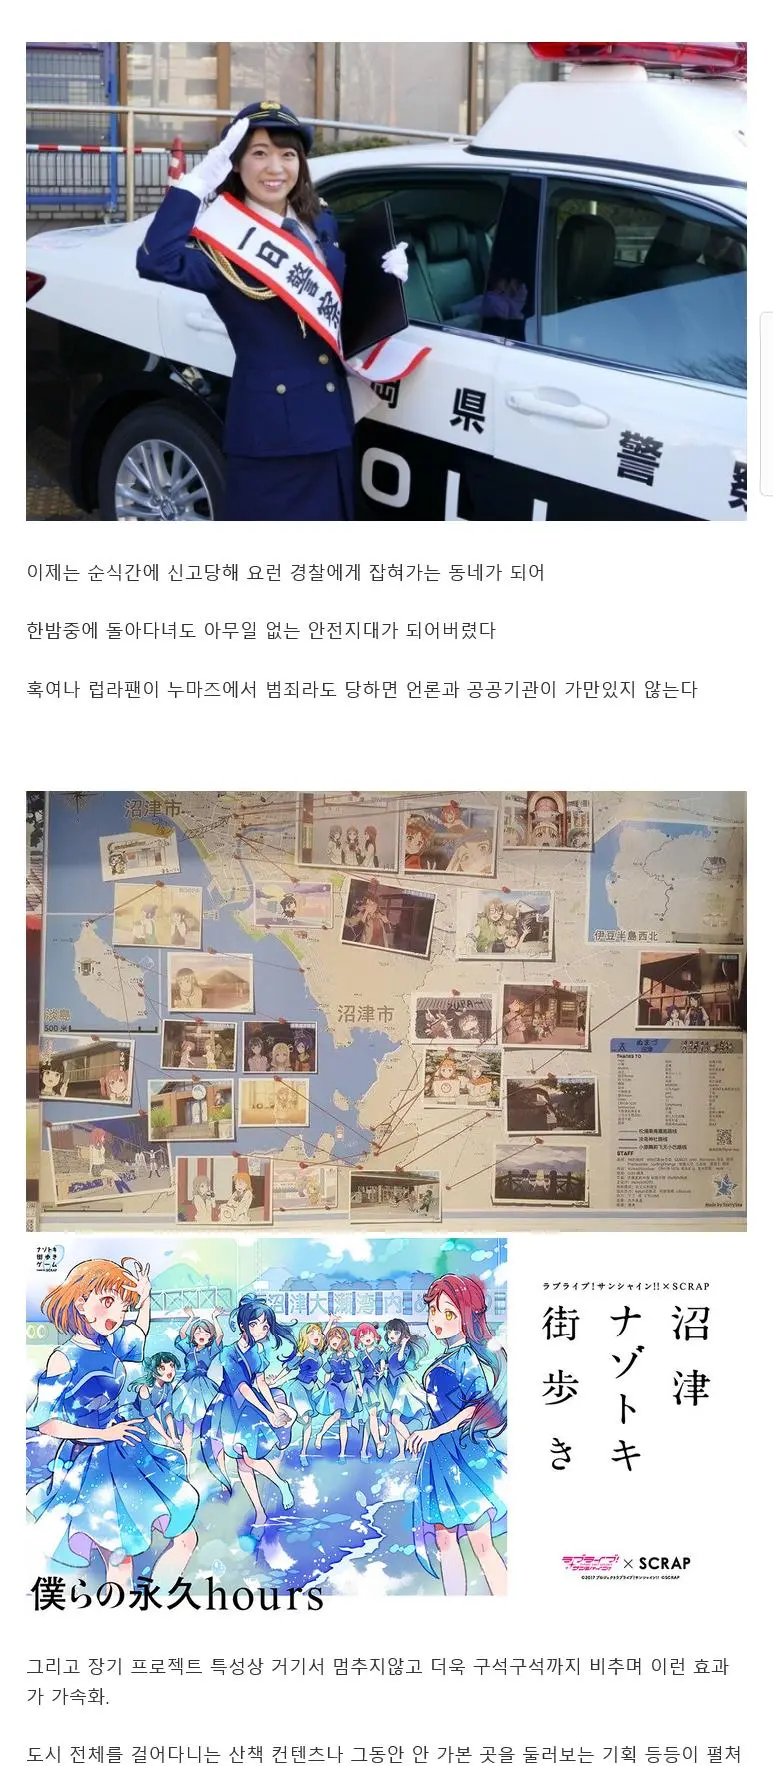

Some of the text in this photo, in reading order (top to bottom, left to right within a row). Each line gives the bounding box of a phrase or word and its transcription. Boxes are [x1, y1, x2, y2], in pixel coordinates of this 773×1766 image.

[125, 799, 182, 817] 沼津市
[338, 1005, 394, 1023] 沼津市
[672, 1305, 711, 1406] 沼津
[542, 1305, 580, 1470] 街歩き
[610, 1305, 645, 1471] ナゾトキ
[639, 1556, 691, 1570] SCRAP
[31, 1576, 324, 1611] 僕らの永久hours
